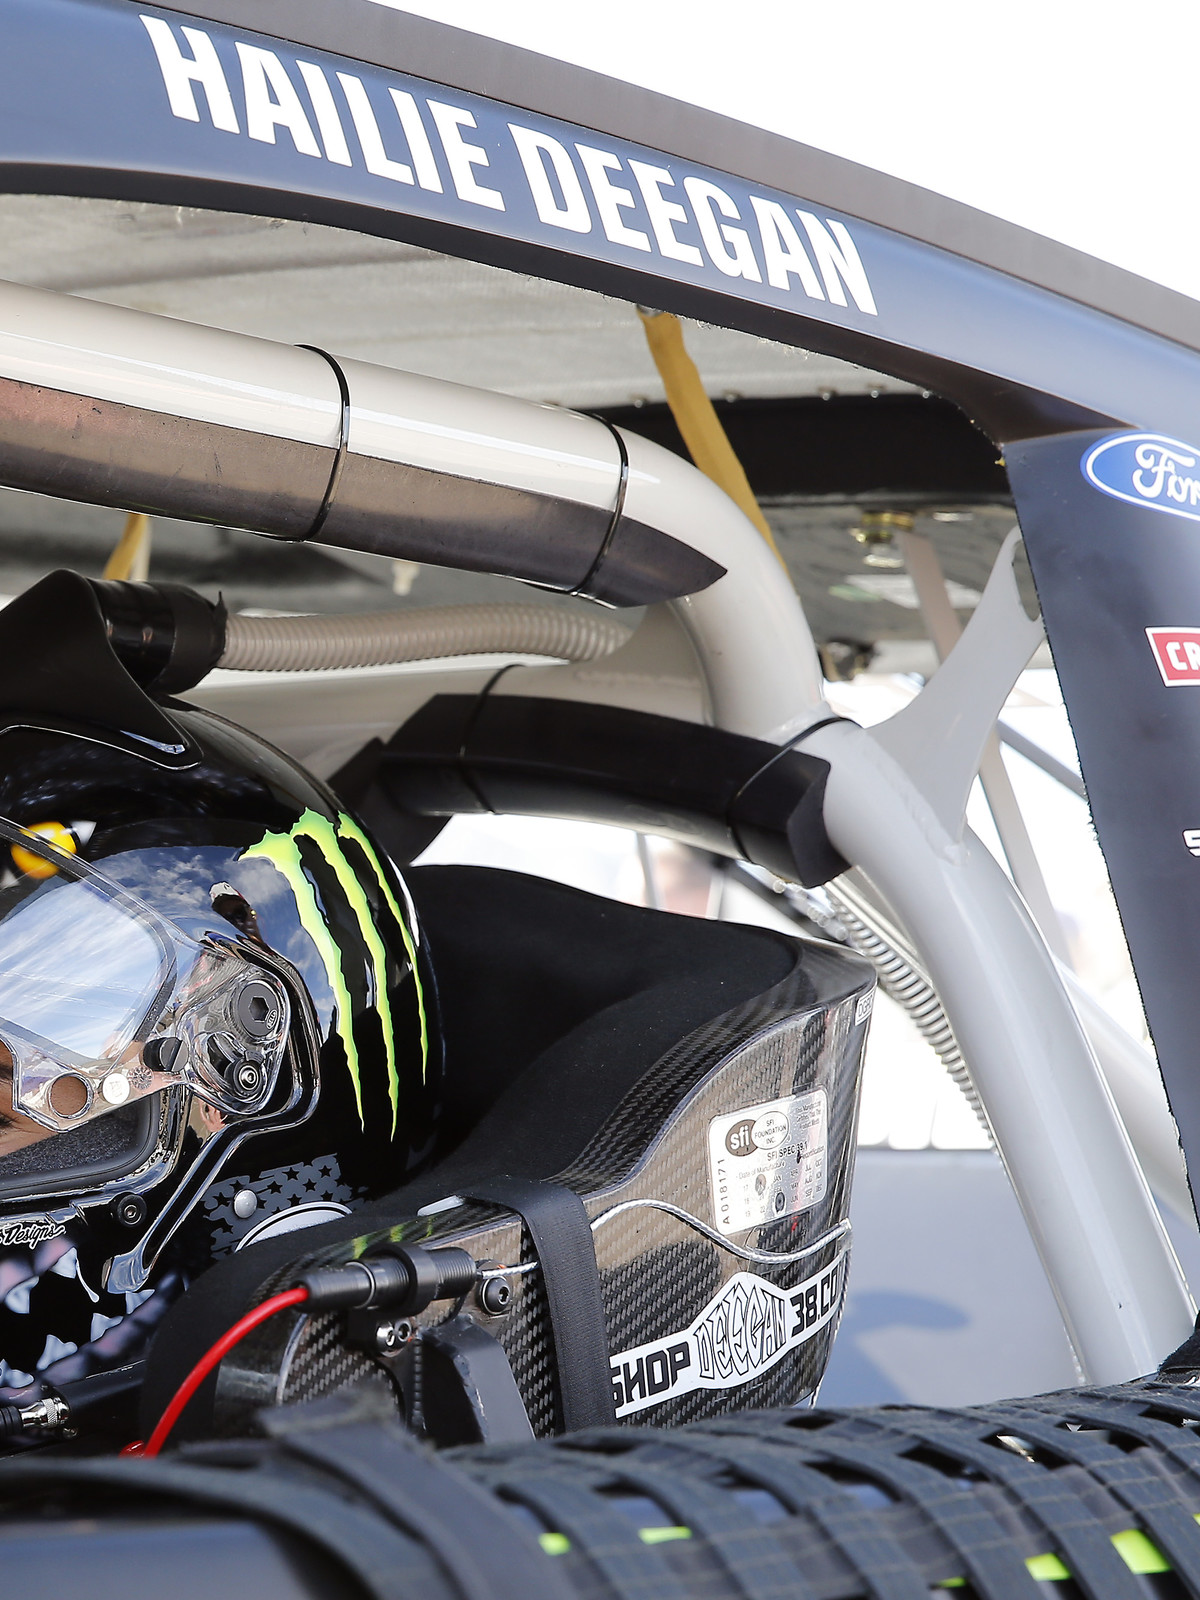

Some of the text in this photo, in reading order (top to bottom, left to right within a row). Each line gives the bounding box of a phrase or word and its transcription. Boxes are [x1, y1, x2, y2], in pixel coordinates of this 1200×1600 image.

[139, 14, 879, 316] HAILIE DEEGAN
[1132, 443, 1200, 506] For
[754, 1125, 787, 1139] FOUNDATION
[766, 1119, 775, 1127] SFI
[730, 1126, 750, 1150] sfi
[767, 1151, 778, 1161] SFI
[779, 1144, 795, 1158] SPEC
[717, 1159, 731, 1226] A018171
[2, 1222, 67, 1250] Designs
[611, 1341, 691, 1409] SHOP
[791, 1266, 843, 1338] 38.CO
